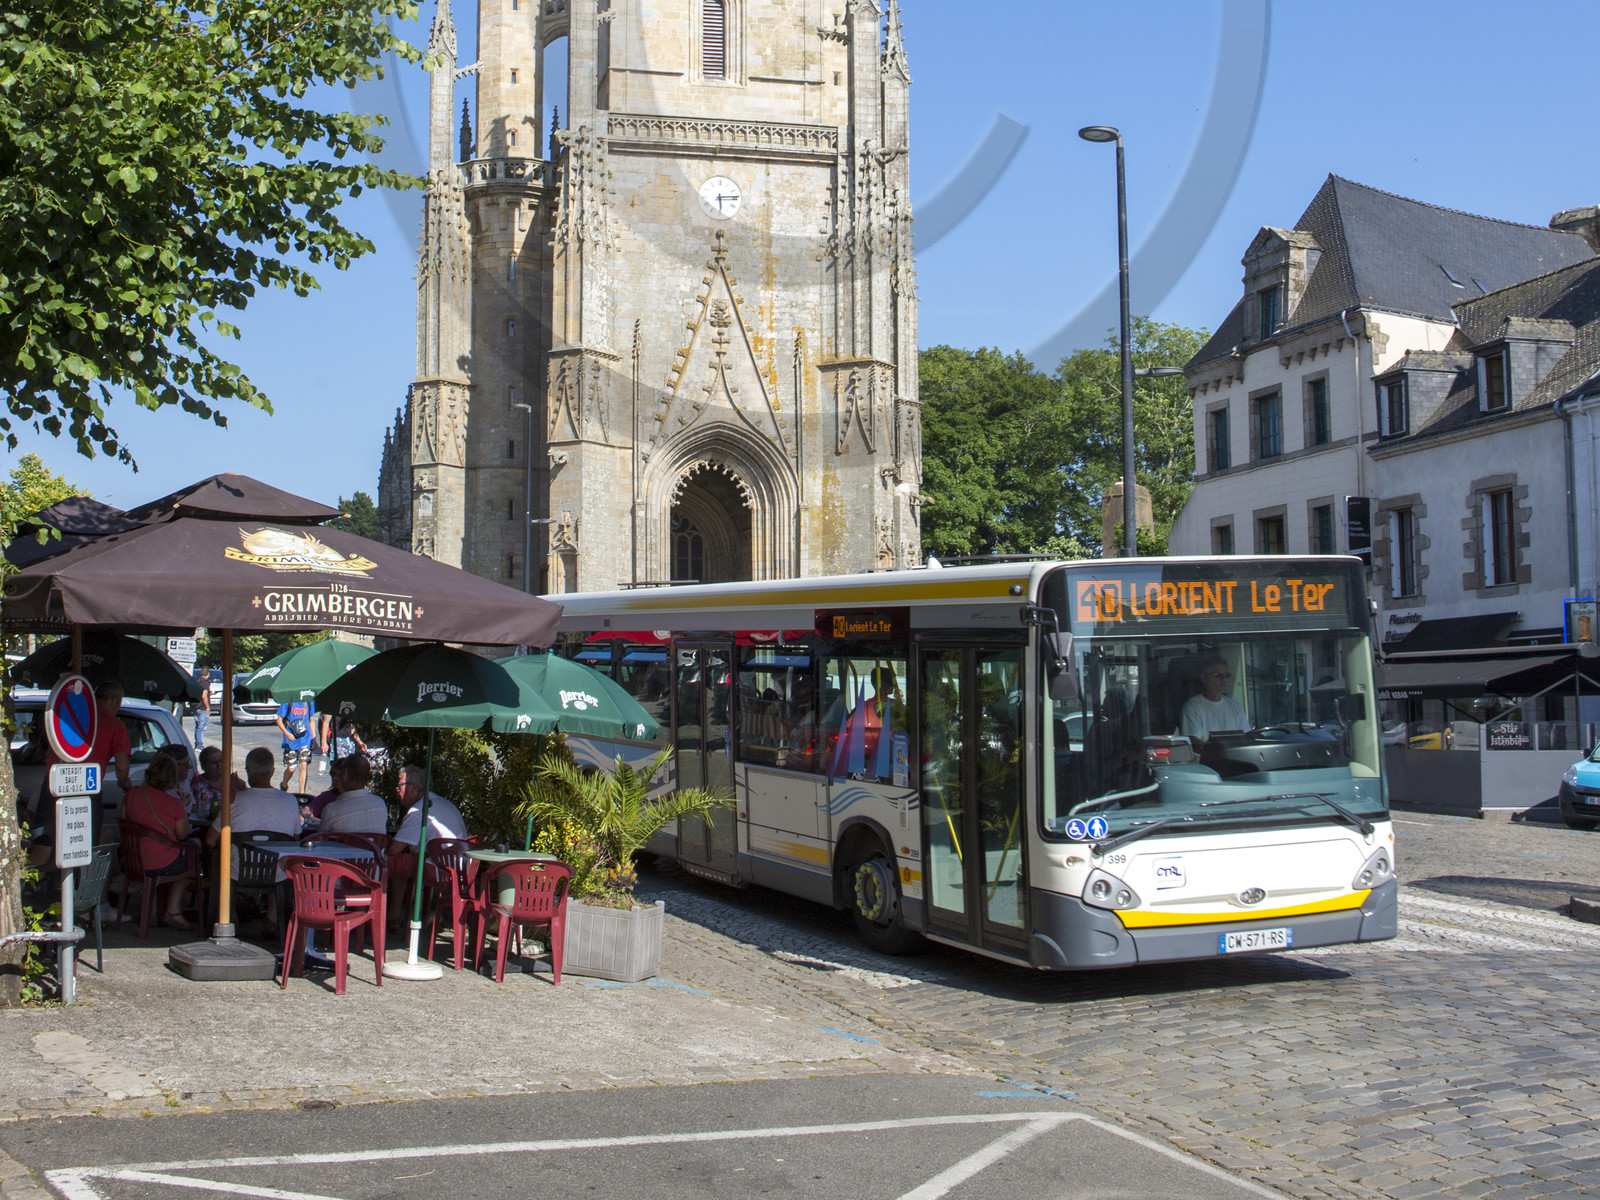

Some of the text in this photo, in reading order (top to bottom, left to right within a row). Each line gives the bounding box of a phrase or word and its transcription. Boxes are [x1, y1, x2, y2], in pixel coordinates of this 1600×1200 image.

[330, 583, 348, 593] 1128
[1079, 579, 1334, 620] 40 LORIENT Le Ter
[263, 592, 413, 620] GRIMBERGEN
[367, 618, 413, 630] D'ABBAYE
[1388, 612, 1422, 625] Fleuriste
[869, 621, 877, 632] Le
[879, 620, 891, 632] Ter
[60, 767, 82, 776] INTERDIT
[65, 775, 78, 784] SAUF
[64, 805, 89, 816] Si tu prends
[66, 822, 73, 830] ma
[69, 834, 84, 846] prends
[63, 852, 72, 860] mon
[910, 848, 920, 858] 399
[1108, 854, 1127, 865] 399
[1156, 865, 1182, 877] CTRL
[1227, 929, 1285, 949] CW-571-RS
